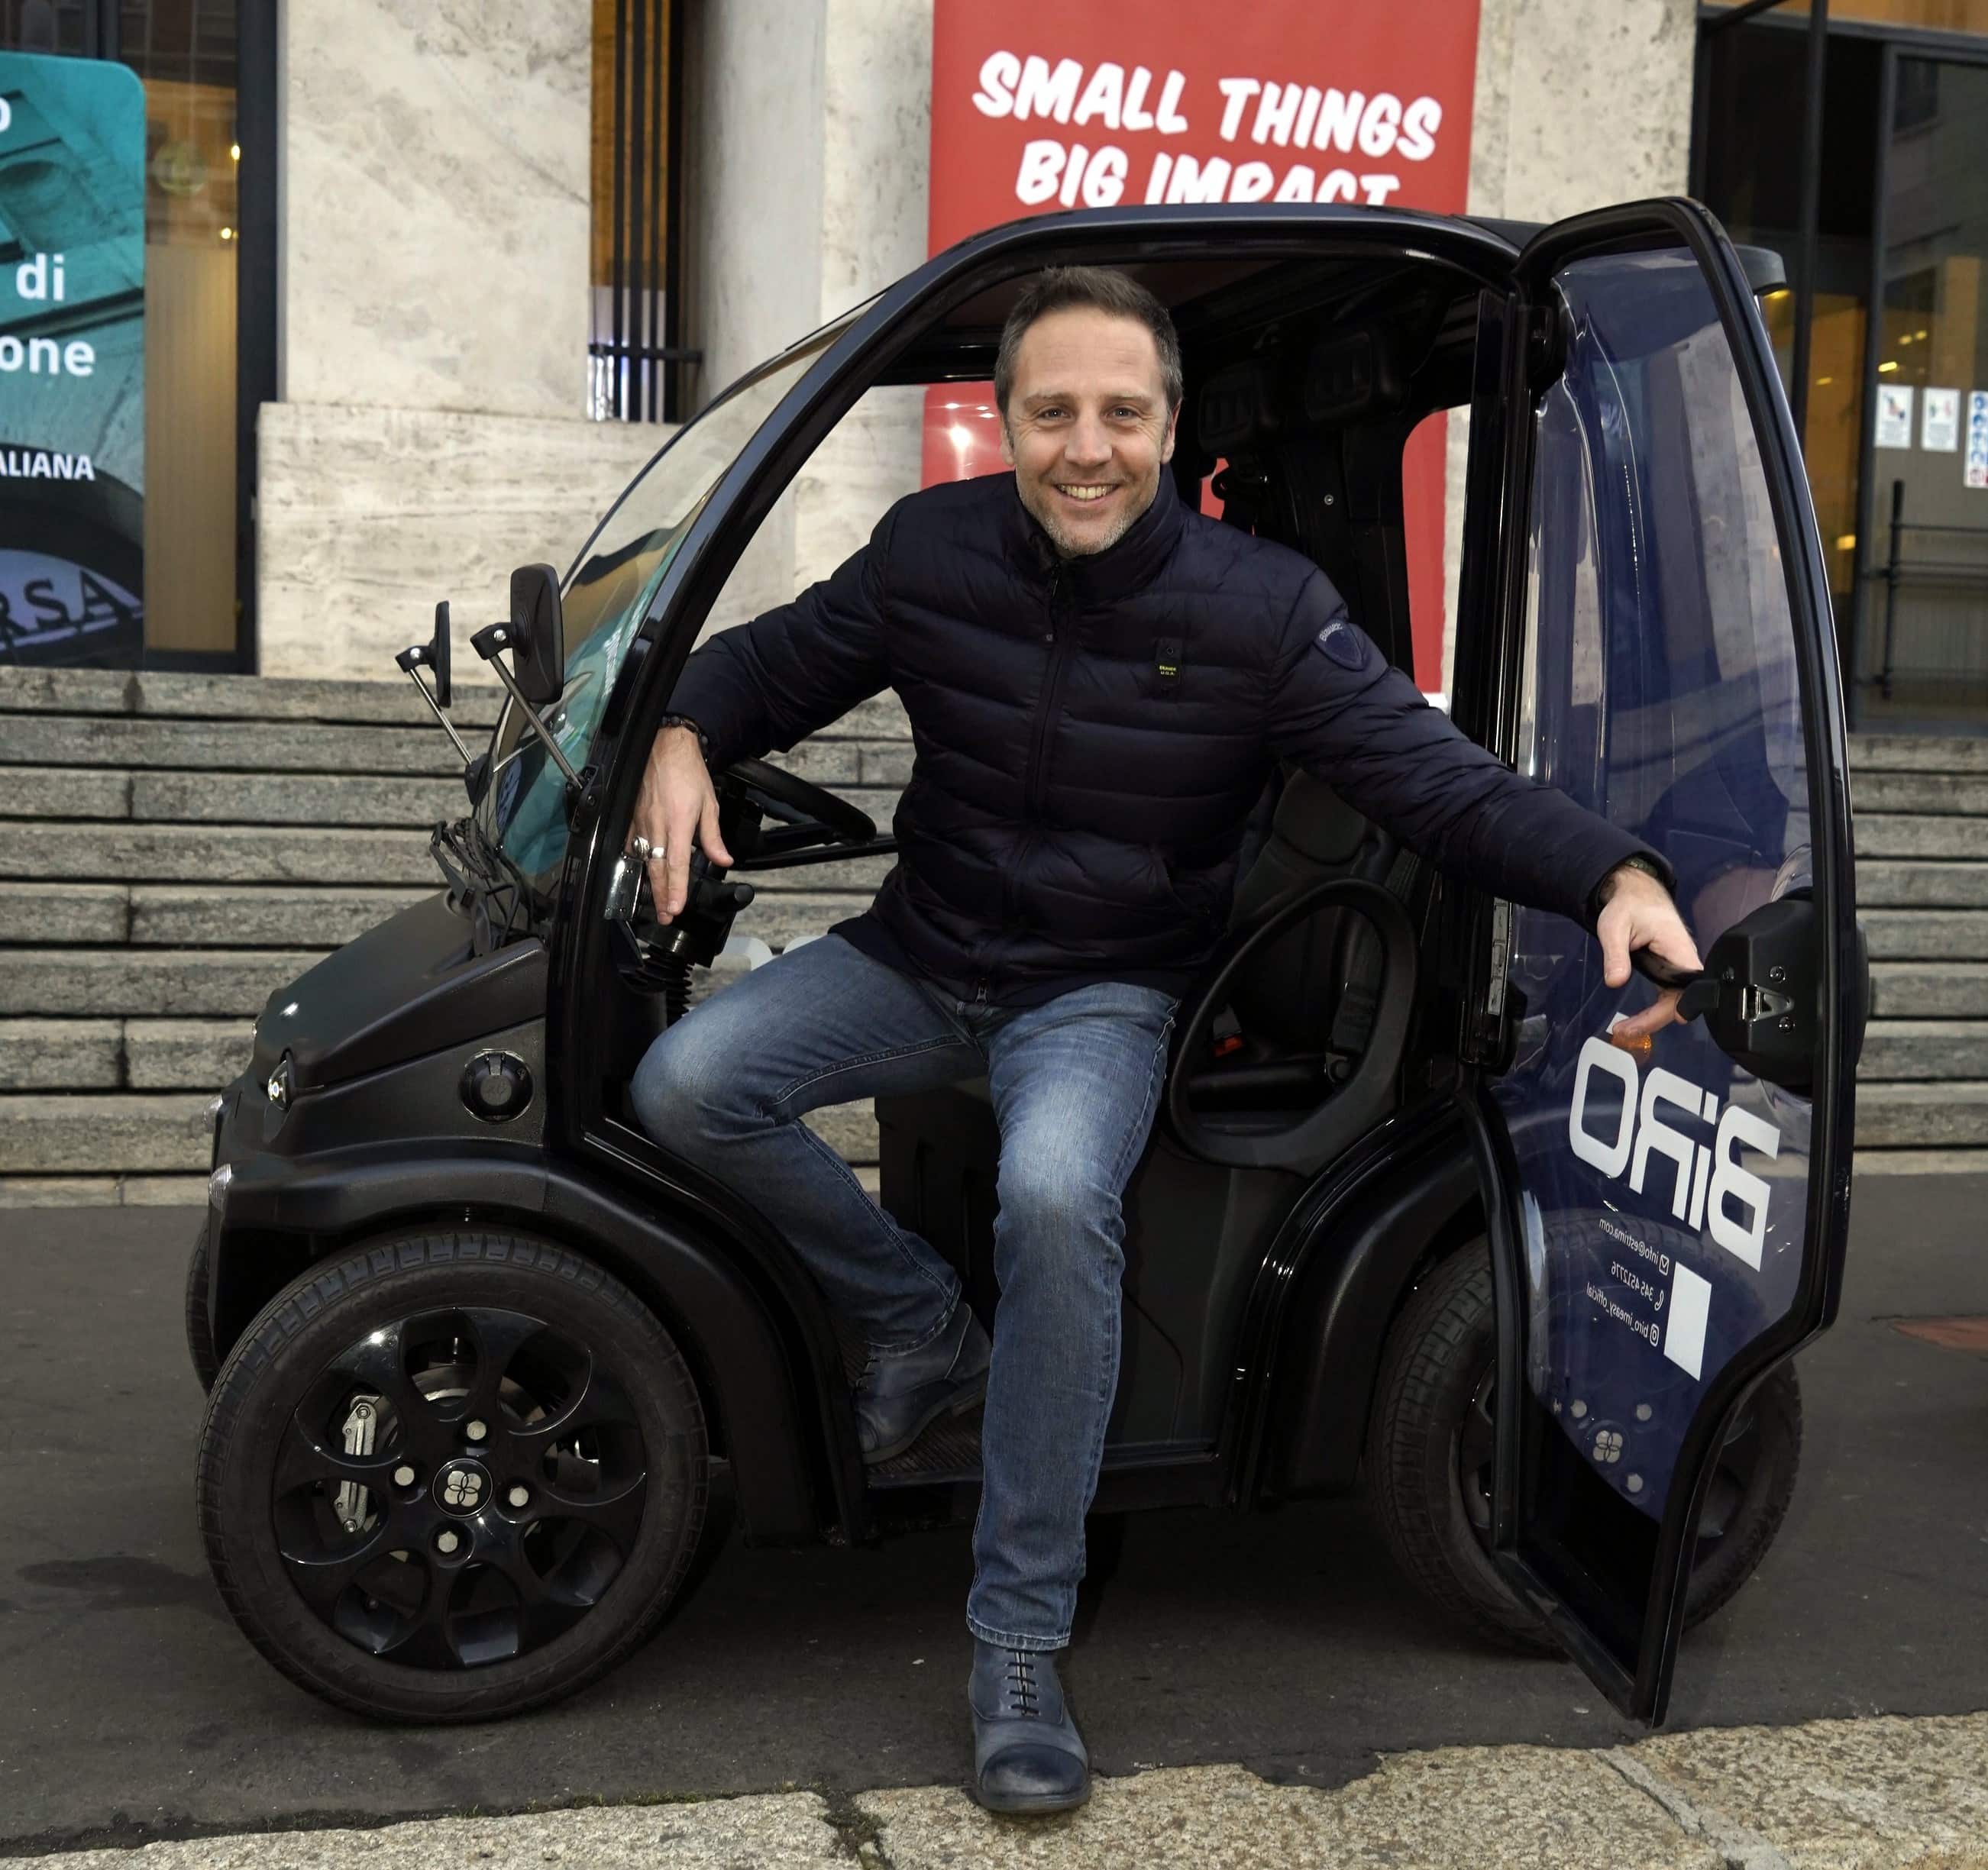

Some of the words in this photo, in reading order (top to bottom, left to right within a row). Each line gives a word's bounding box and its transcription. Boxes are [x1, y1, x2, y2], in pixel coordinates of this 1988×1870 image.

[972, 50, 1188, 134] SMALL
[1219, 78, 1443, 160] THINGS
[1015, 139, 1129, 208] BIG
[16, 253, 65, 302] di
[0, 334, 96, 376] one
